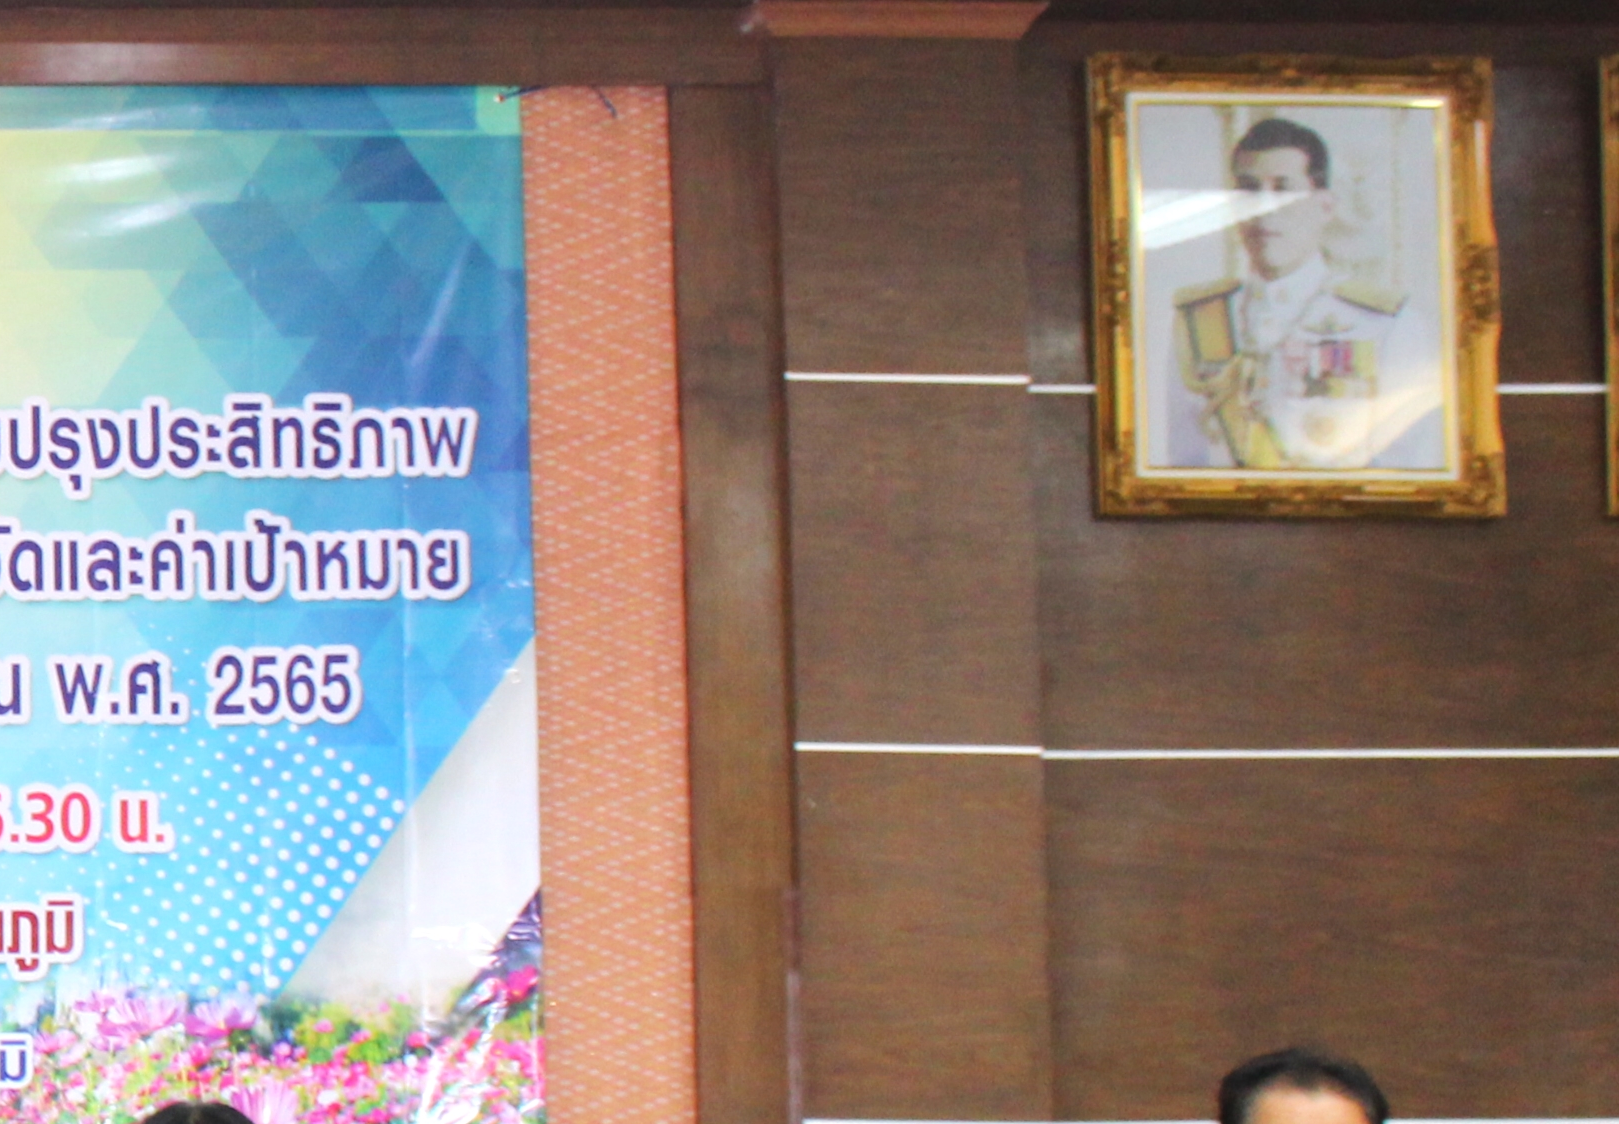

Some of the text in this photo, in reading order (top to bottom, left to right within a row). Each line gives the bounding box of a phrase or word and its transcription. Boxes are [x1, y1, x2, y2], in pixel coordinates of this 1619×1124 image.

[55, 658, 180, 716] พ.ศ.
[212, 654, 352, 717] 2565
[119, 797, 165, 845] น.
